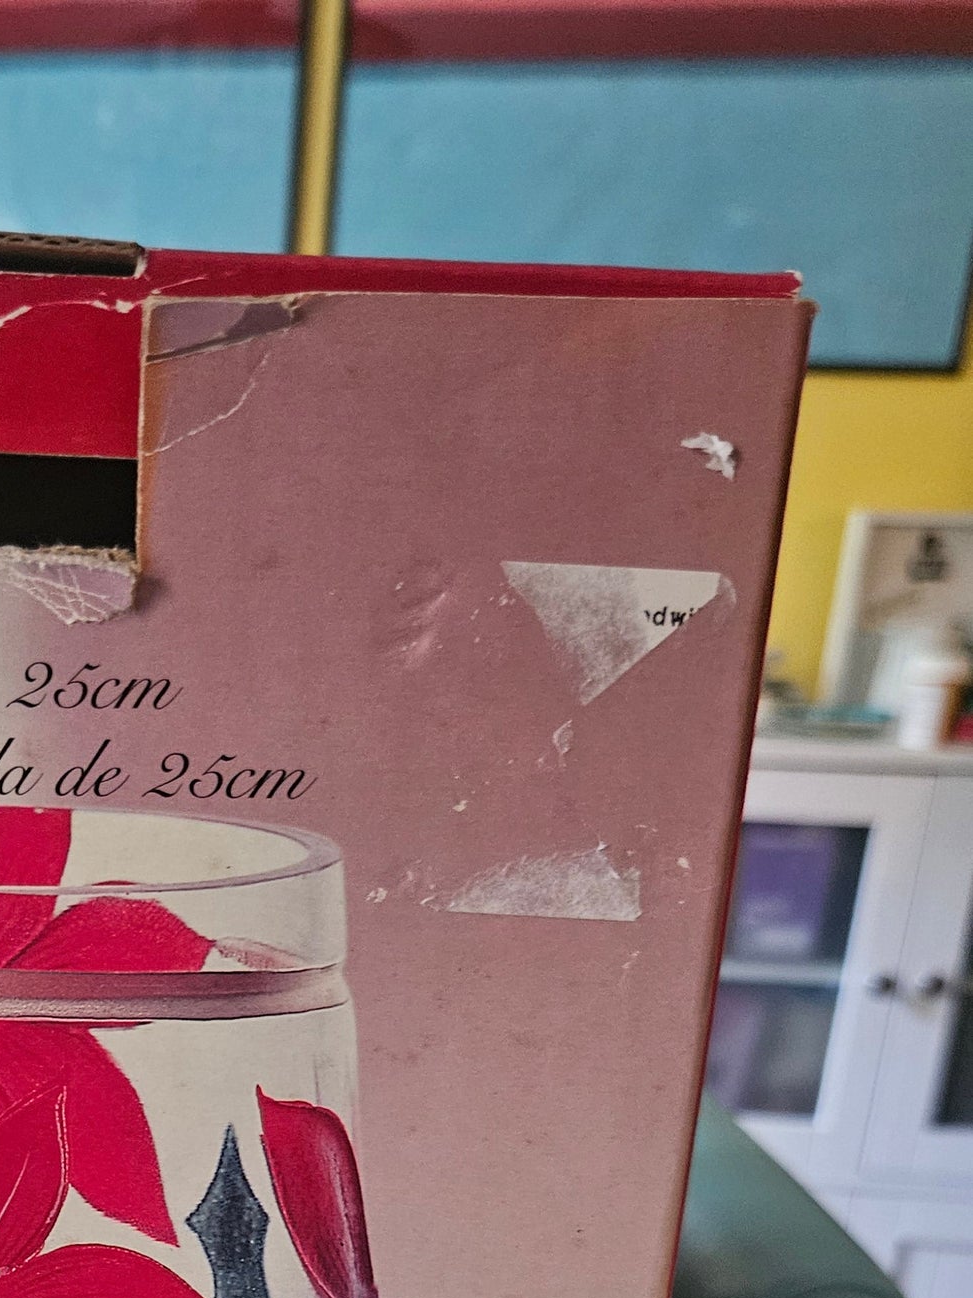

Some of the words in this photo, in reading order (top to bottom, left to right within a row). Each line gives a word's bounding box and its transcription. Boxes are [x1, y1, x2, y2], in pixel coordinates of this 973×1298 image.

[6, 661, 184, 710] 25cm
[54, 739, 131, 798] de
[142, 752, 319, 800] 25cm
